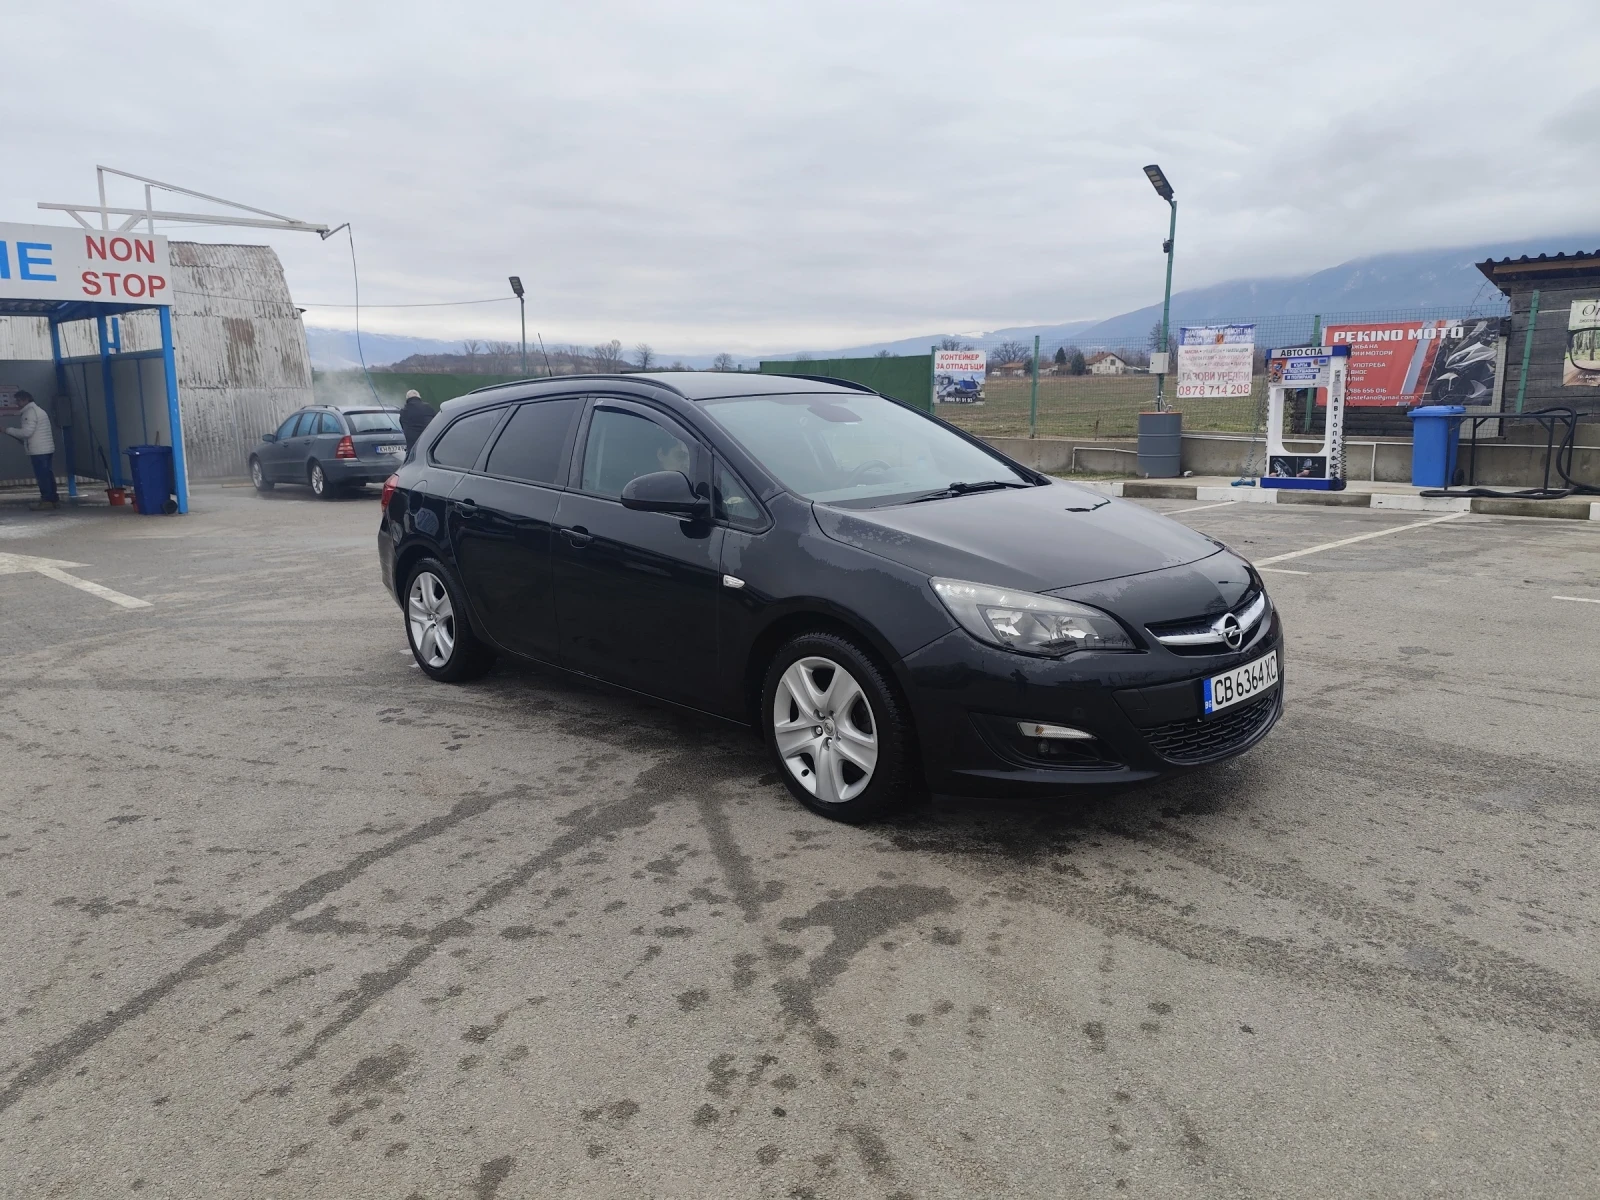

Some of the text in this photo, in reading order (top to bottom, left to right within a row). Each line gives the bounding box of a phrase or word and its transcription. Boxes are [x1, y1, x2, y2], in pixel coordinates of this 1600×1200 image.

[85, 234, 155, 264] NON
[81, 271, 166, 298] STOP
[1333, 326, 1464, 343] PEKINO MOTO
[940, 353, 979, 361] КОНТЕЙНЕР
[1280, 347, 1323, 357] АВТО СПА
[946, 362, 985, 371] ОТПАДЪЦИ
[1182, 371, 1250, 382] ГАЗОВИ УРЕДБИ
[1178, 384, 1250, 396] 0878 714 208
[1214, 655, 1277, 705] CB 6364 XC
